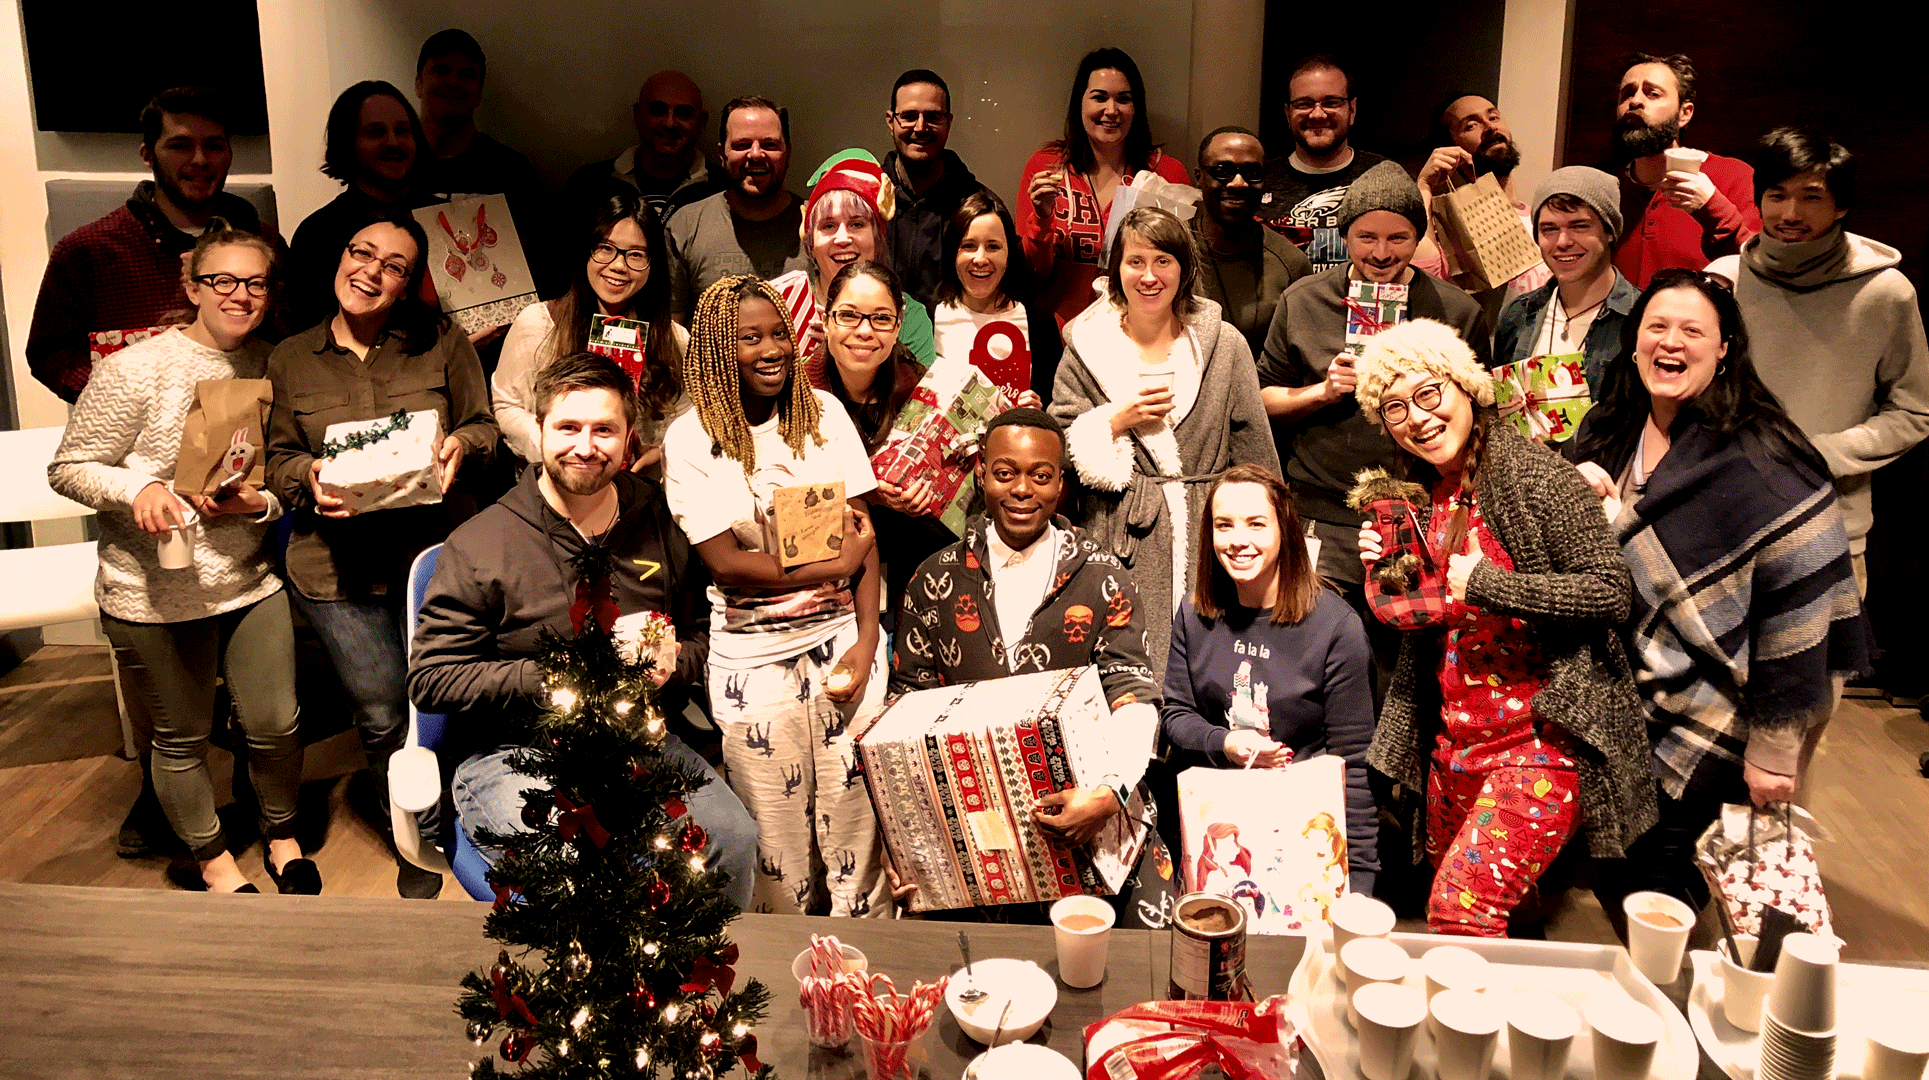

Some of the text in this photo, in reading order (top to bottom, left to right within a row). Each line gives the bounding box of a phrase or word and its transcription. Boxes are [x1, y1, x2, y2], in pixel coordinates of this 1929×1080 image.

[942, 551, 959, 563] SA
[1233, 639, 1271, 660] fa la la
